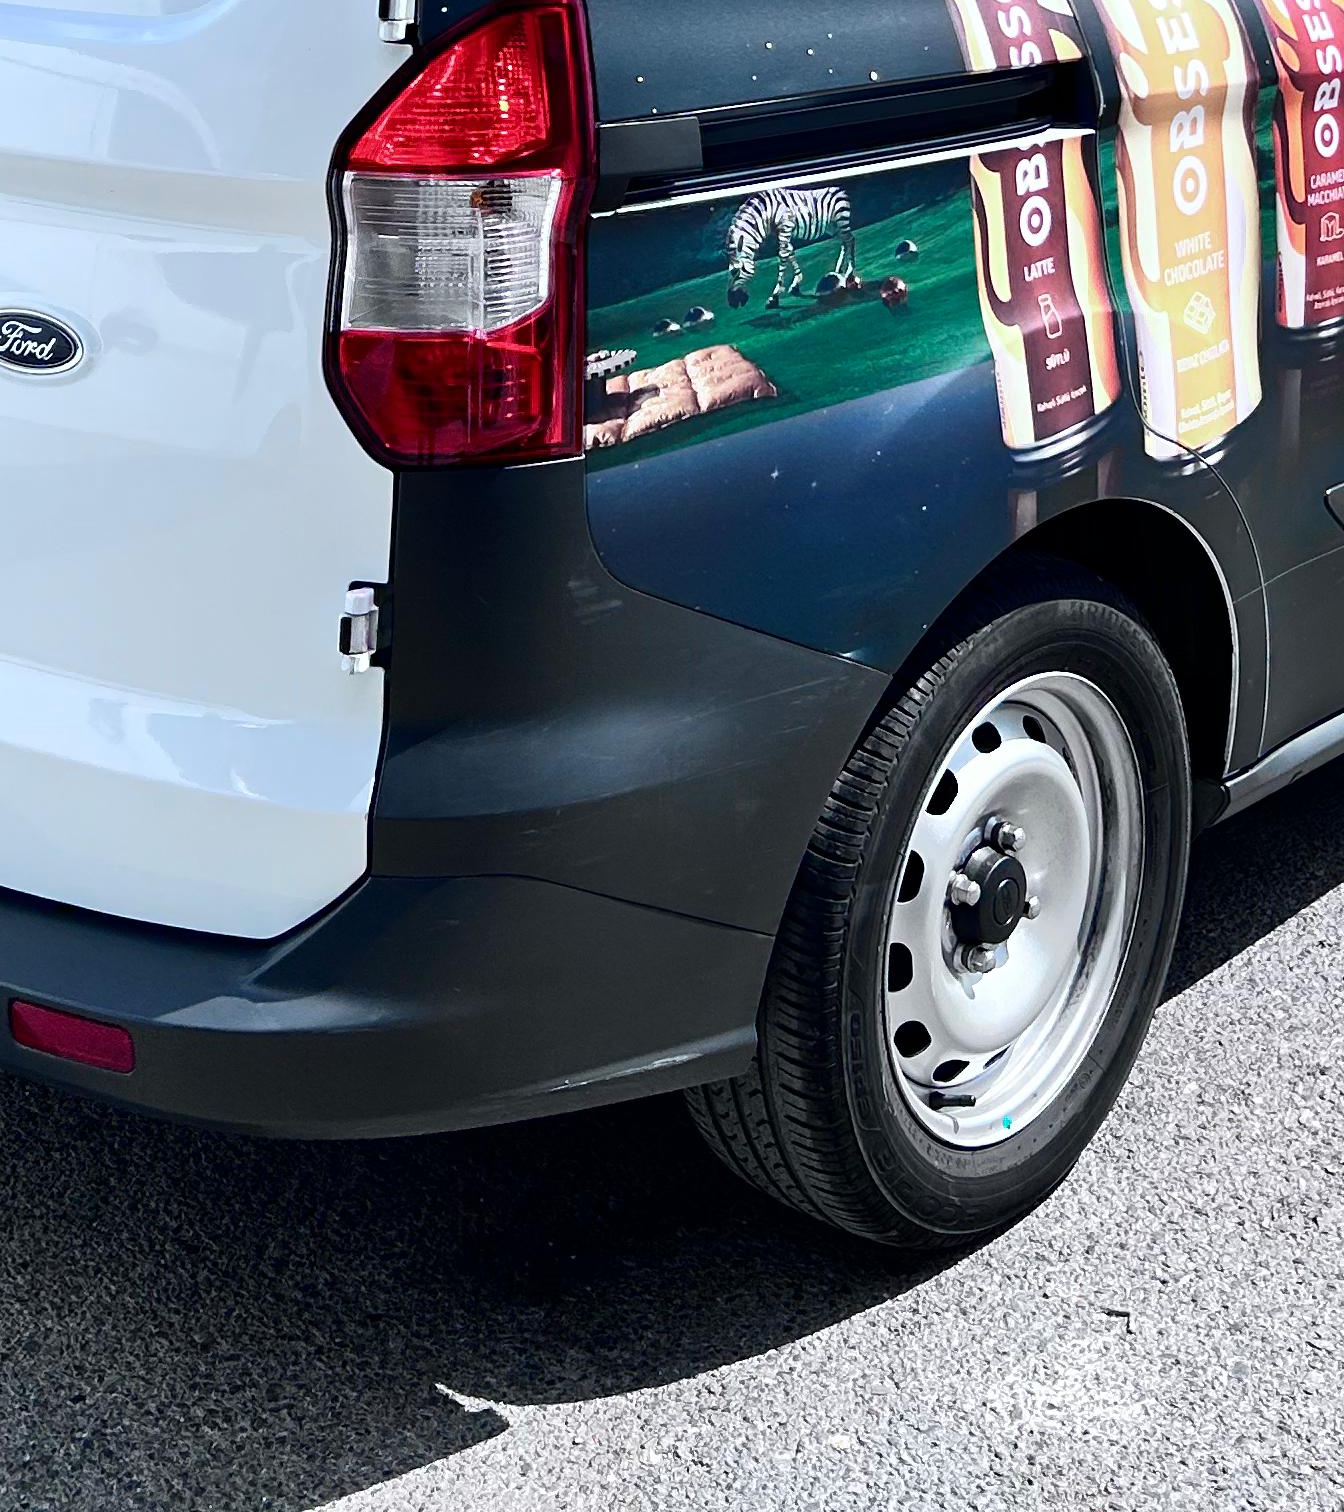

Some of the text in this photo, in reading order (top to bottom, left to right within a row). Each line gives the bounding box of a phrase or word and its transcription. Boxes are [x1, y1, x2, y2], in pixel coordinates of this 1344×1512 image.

[1174, 231, 1212, 258] WHITE
[1023, 256, 1056, 282] LATTE
[1164, 249, 1225, 287] CHOCOLATE
